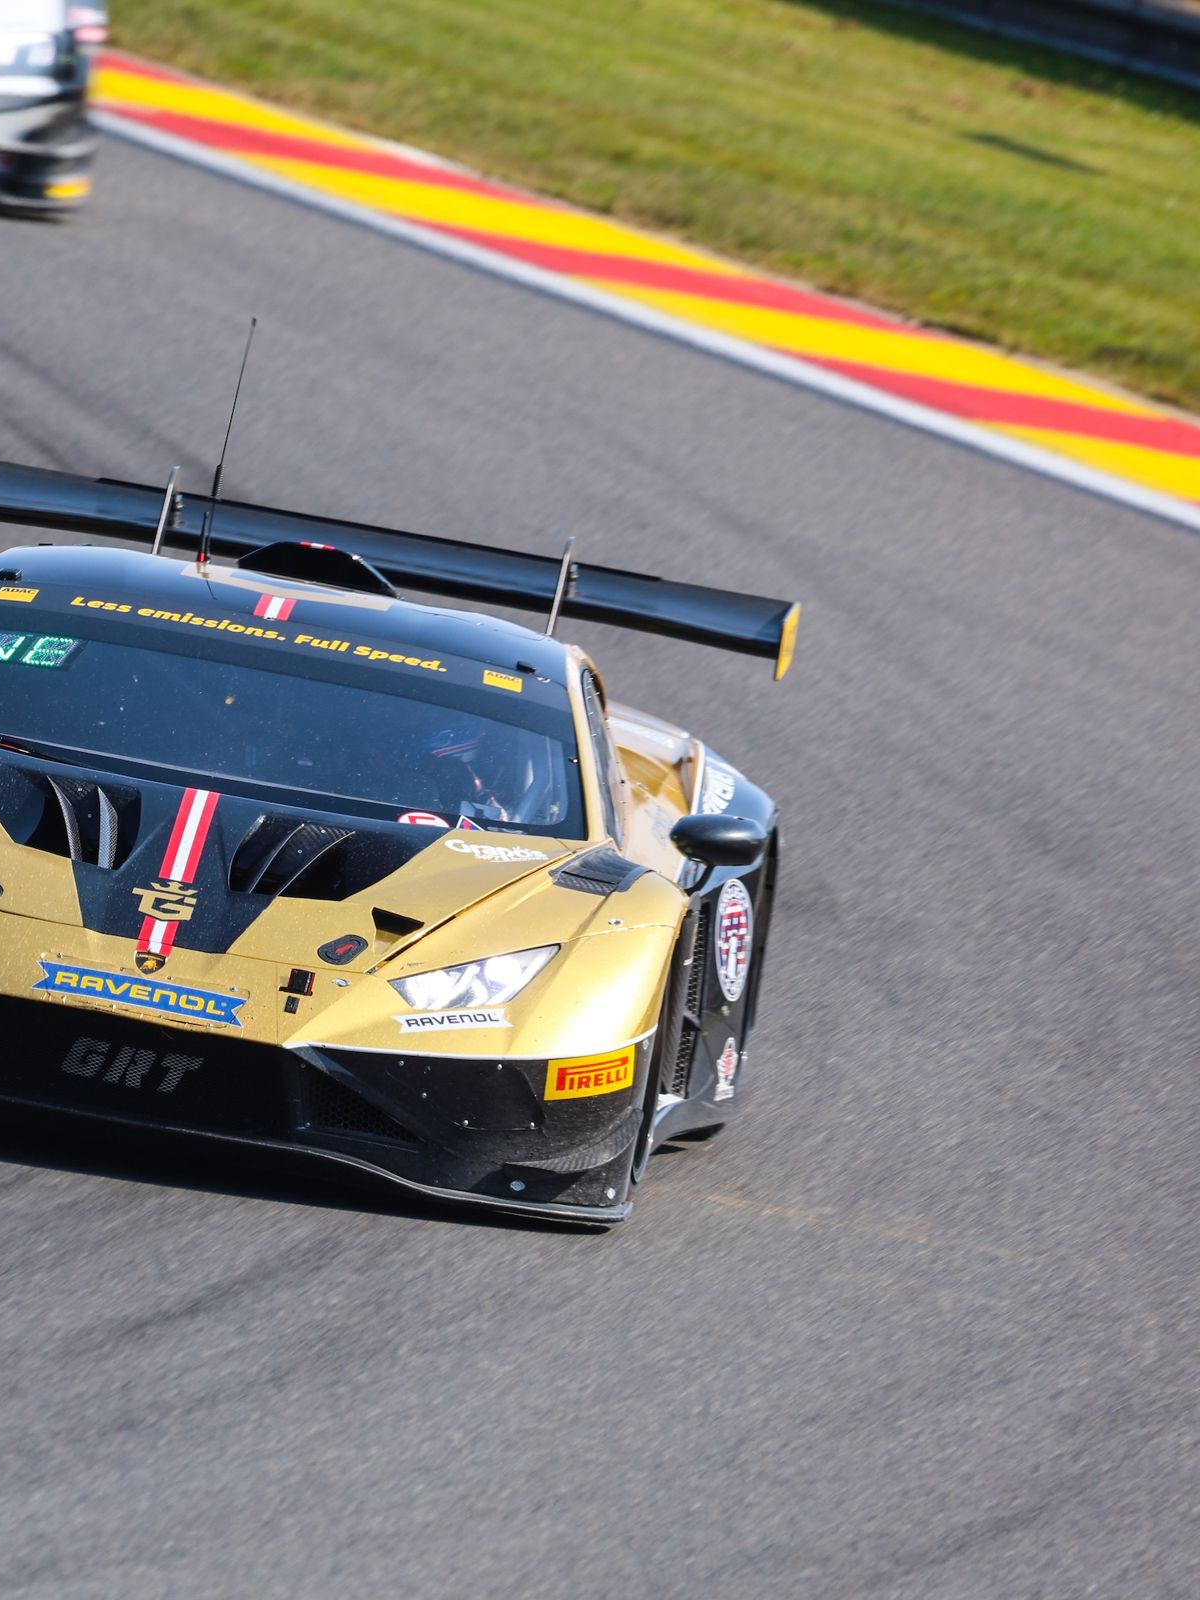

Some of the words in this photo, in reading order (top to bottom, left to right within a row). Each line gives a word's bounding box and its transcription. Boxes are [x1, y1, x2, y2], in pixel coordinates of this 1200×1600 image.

[70, 596, 132, 613] Less
[137, 607, 287, 641] emissions.
[294, 634, 349, 652] Full
[352, 645, 448, 672] Speed.
[54, 971, 226, 1016] RAVENOL
[406, 1013, 500, 1028] RAVENOL
[61, 1036, 204, 1094] GRT
[556, 1056, 629, 1091] PIRELLI
